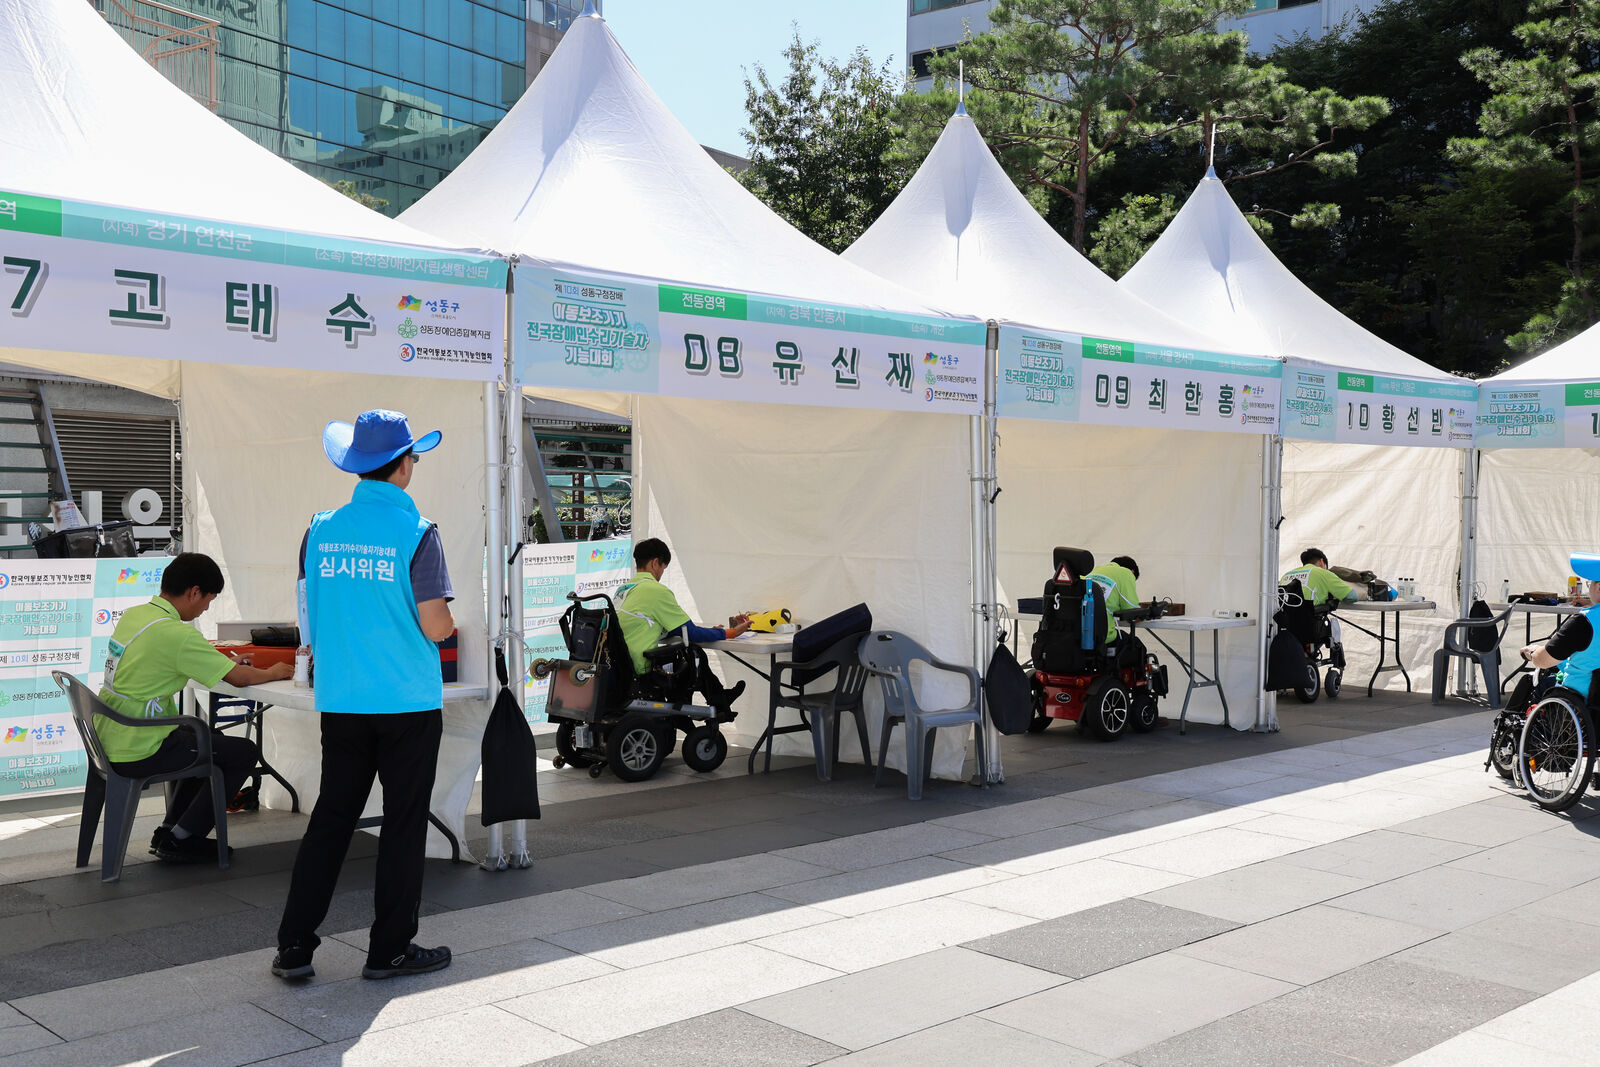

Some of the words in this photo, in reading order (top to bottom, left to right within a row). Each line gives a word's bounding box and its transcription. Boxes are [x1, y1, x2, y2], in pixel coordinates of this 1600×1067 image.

[101, 218, 140, 237] (지역)
[145, 218, 188, 244] 경기
[195, 225, 253, 252] 연천군
[554, 283, 562, 293] 제
[564, 284, 579, 295] 10회
[580, 287, 624, 301] 성동구청장배
[425, 299, 460, 314] 성동구
[682, 292, 726, 311] 전동영역
[552, 302, 628, 329] 이동보조기기
[789, 304, 811, 321] 경북
[813, 307, 846, 326] 안동시
[527, 321, 649, 351] 전국장애인수리기술자
[416, 347, 493, 361] 한국이동보조기기기능인협회
[565, 345, 614, 368] 기능대회
[684, 333, 743, 376] 08
[1095, 342, 1122, 357] 전동영역
[940, 354, 959, 365] 성동구
[1096, 374, 1130, 407] 09
[1348, 402, 1369, 430] 10
[605, 548, 625, 560] 성동구
[142, 568, 162, 583] 성동
[318, 556, 395, 582] 심사위원
[11, 574, 92, 583] 한국이동보조기기기능인협회
[15, 601, 68, 612] 이동보조기기
[23, 624, 58, 636] 기능대회
[11, 654, 29, 664] 10회
[32, 652, 80, 663] 성동구청장배
[31, 724, 66, 740] 성동구
